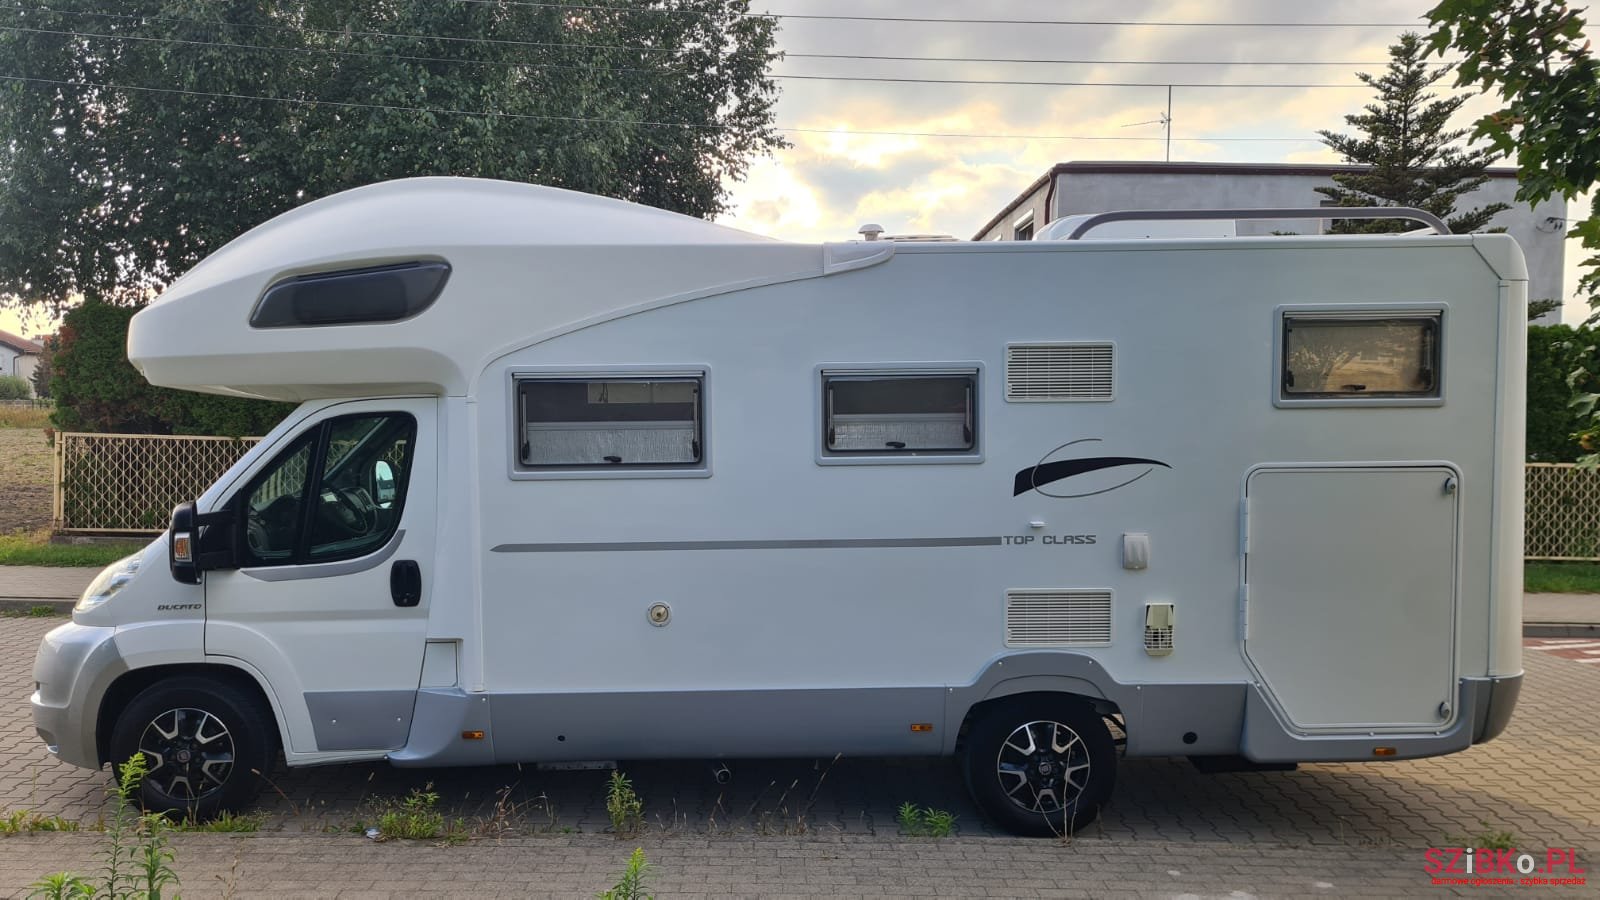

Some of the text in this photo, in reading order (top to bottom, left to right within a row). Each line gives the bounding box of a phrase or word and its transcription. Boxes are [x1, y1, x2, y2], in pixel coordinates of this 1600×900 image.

[1003, 535, 1097, 545] TOP CLASS
[157, 603, 202, 611] DUCATO
